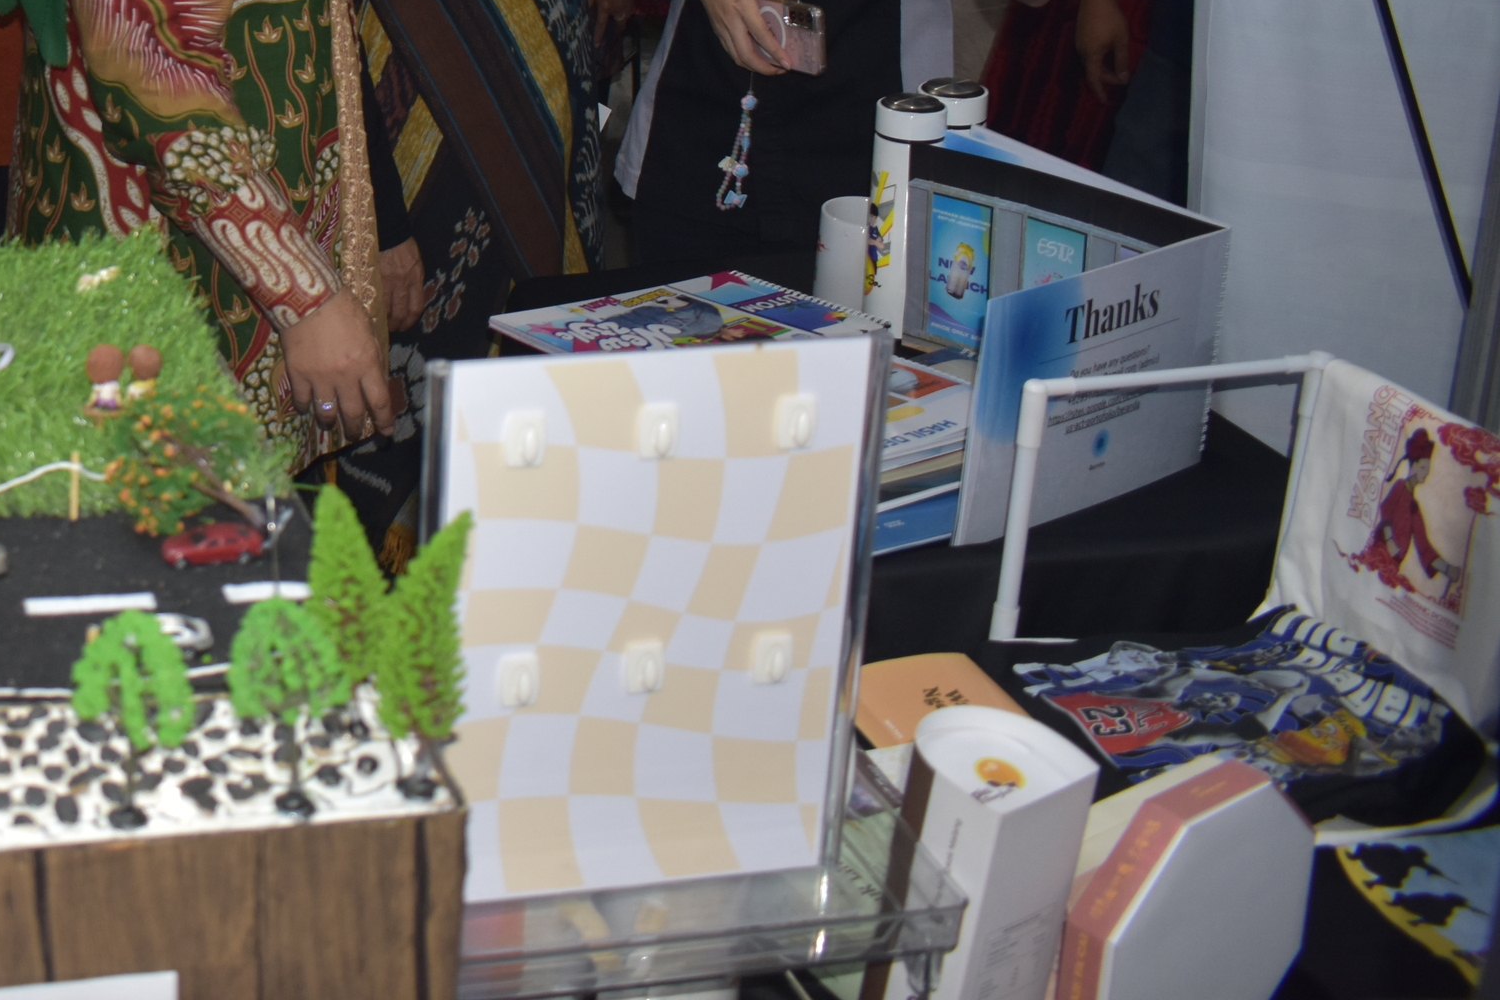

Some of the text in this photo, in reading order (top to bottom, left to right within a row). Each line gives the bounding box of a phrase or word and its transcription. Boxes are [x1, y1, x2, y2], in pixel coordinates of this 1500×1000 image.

[1065, 283, 1161, 345] Thanks
[1079, 365, 1092, 377] you
[1092, 361, 1107, 372] have
[1107, 357, 1120, 368] any
[906, 419, 957, 444] HASIL
[1347, 385, 1395, 519] WAYANG
[1082, 703, 1136, 738] 23
